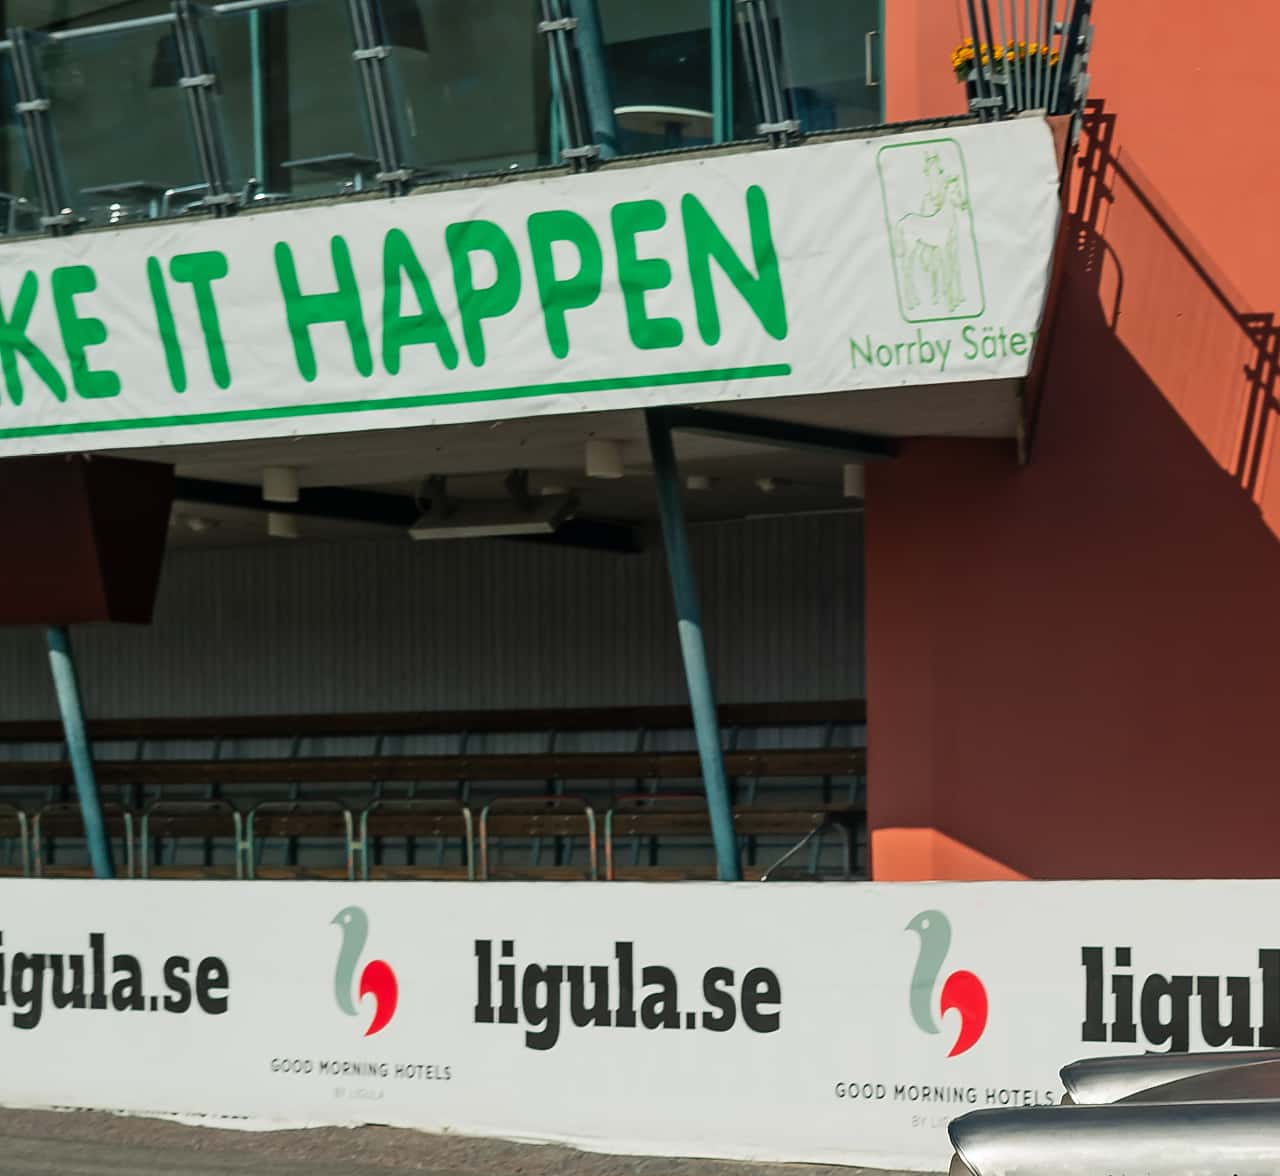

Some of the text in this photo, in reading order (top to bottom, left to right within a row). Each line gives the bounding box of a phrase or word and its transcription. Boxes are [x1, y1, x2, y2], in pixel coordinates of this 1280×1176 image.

[146, 251, 231, 393] IT
[273, 185, 788, 382] HAPPEN
[850, 328, 952, 372] Norrby
[475, 940, 781, 1050] ligula.se
[271, 1058, 451, 1081] GOOD MORNING HOTELS
[835, 1082, 1054, 1106] GOOD MORNING HOTELS
